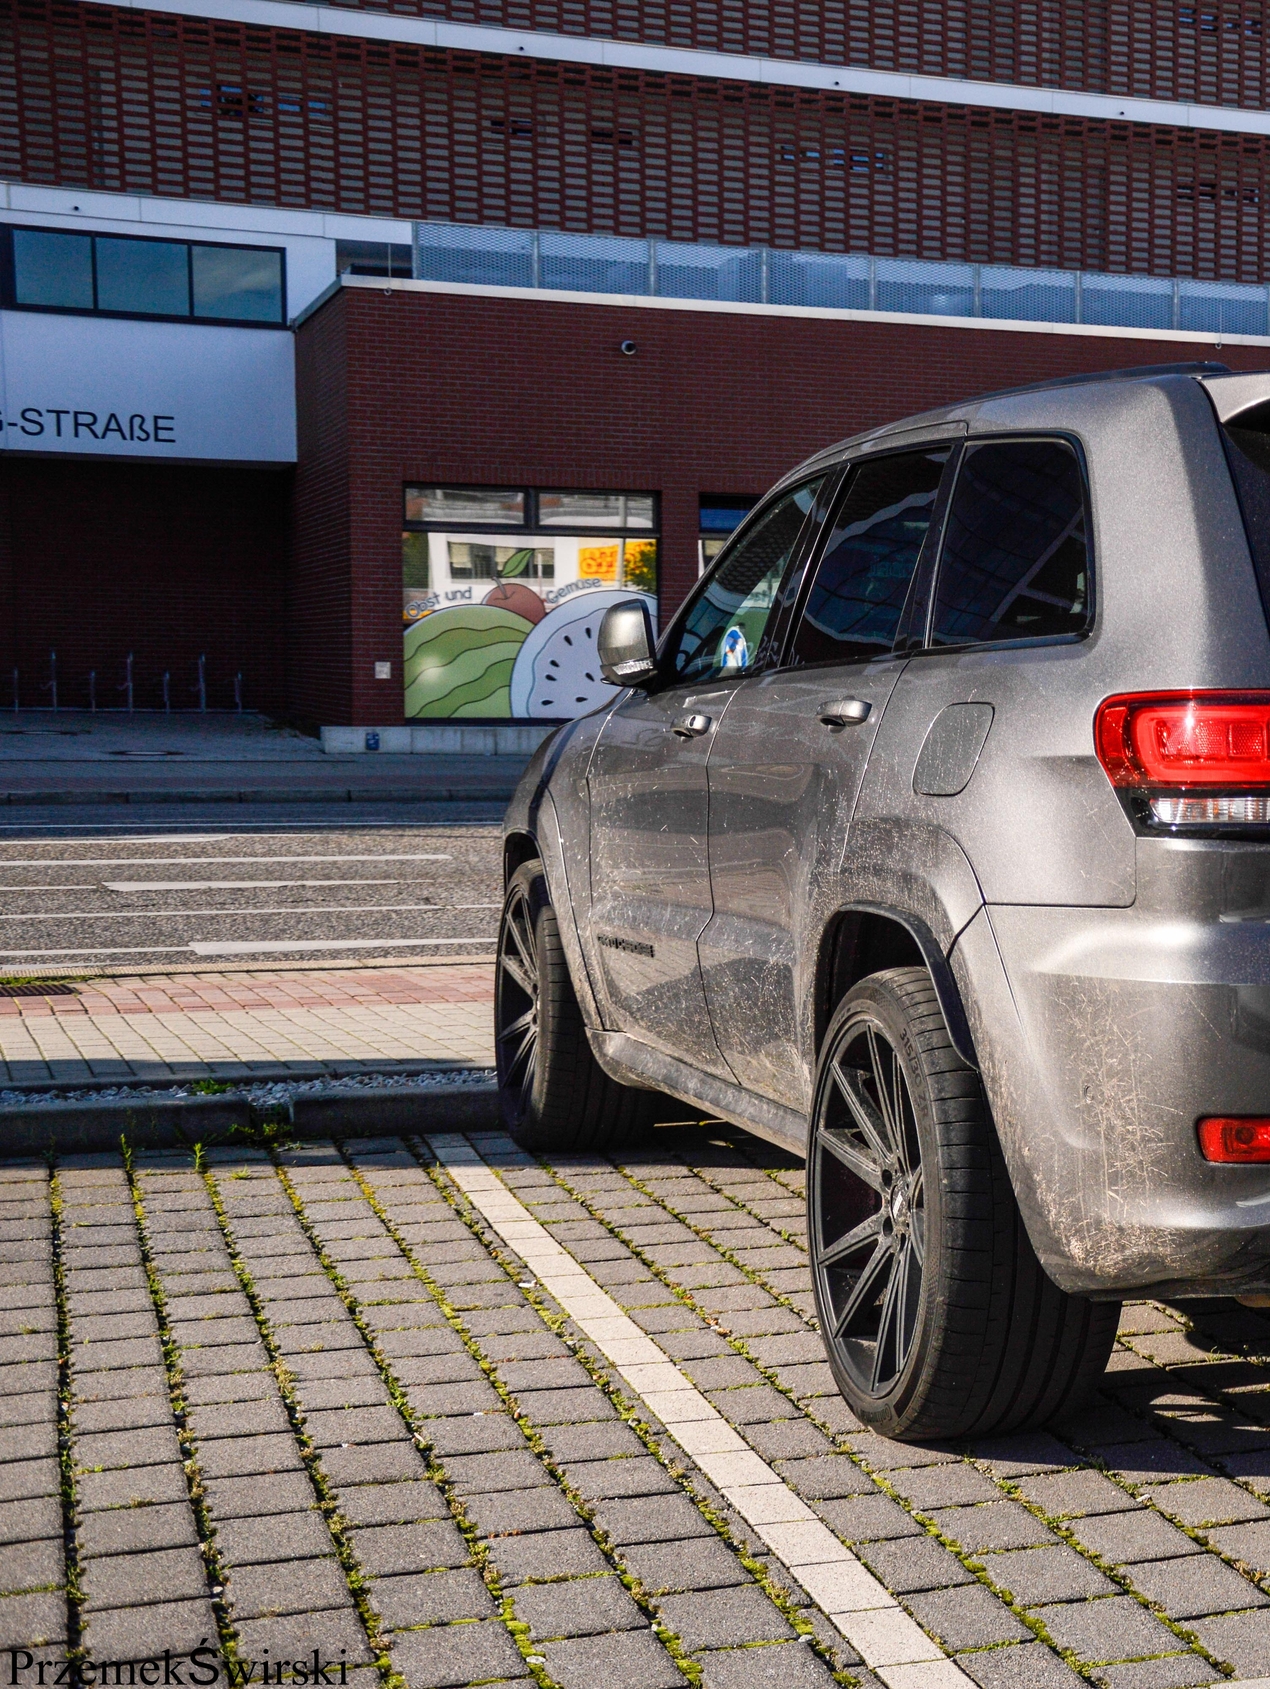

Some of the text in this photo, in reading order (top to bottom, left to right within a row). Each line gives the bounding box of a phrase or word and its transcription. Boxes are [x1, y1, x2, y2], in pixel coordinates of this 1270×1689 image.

[0, 408, 176, 443] -STRAßE
[405, 586, 472, 618] Obst und
[546, 576, 602, 604] Gemüse
